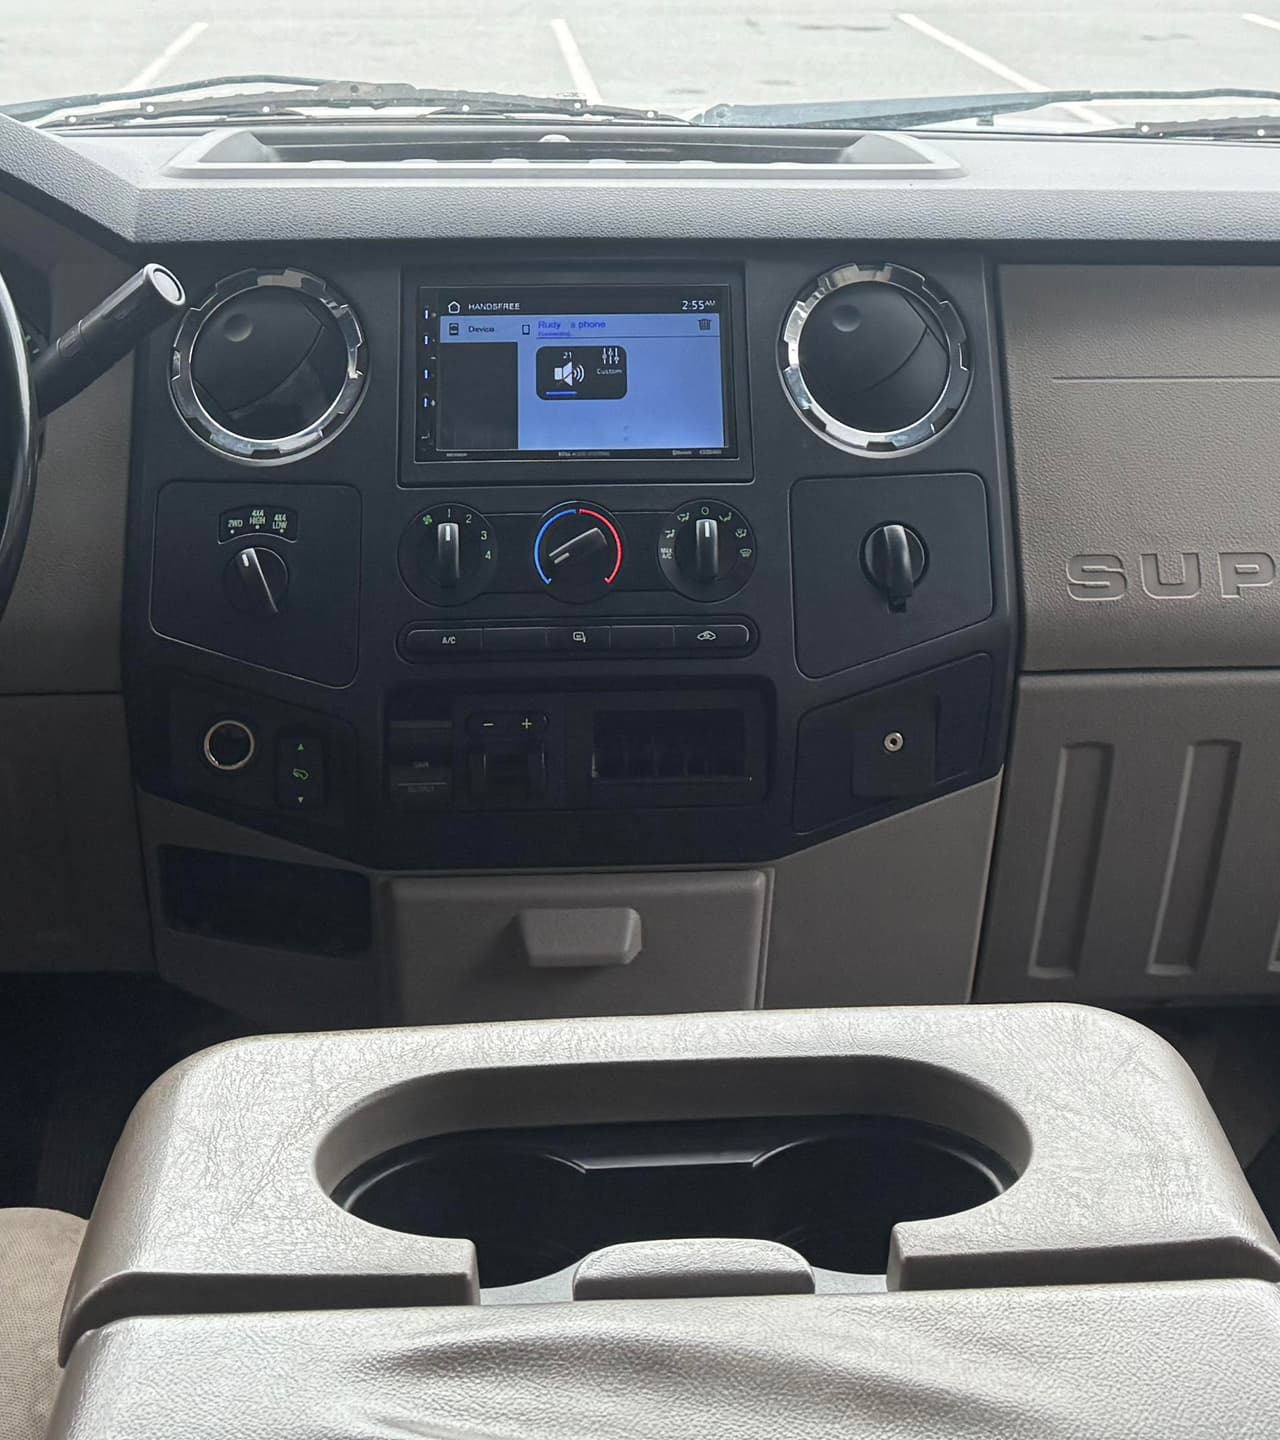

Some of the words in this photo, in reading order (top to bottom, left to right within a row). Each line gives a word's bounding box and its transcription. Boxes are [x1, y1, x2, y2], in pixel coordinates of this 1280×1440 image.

[468, 302, 521, 311] HANDSFREE
[468, 325, 495, 333] Device
[578, 320, 607, 329] phone
[465, 513, 473, 524] 2
[227, 519, 243, 528] 2WD
[272, 521, 288, 529] LOW
[480, 530, 488, 541] 3
[484, 550, 492, 560] 4
[441, 635, 457, 645] A/C
